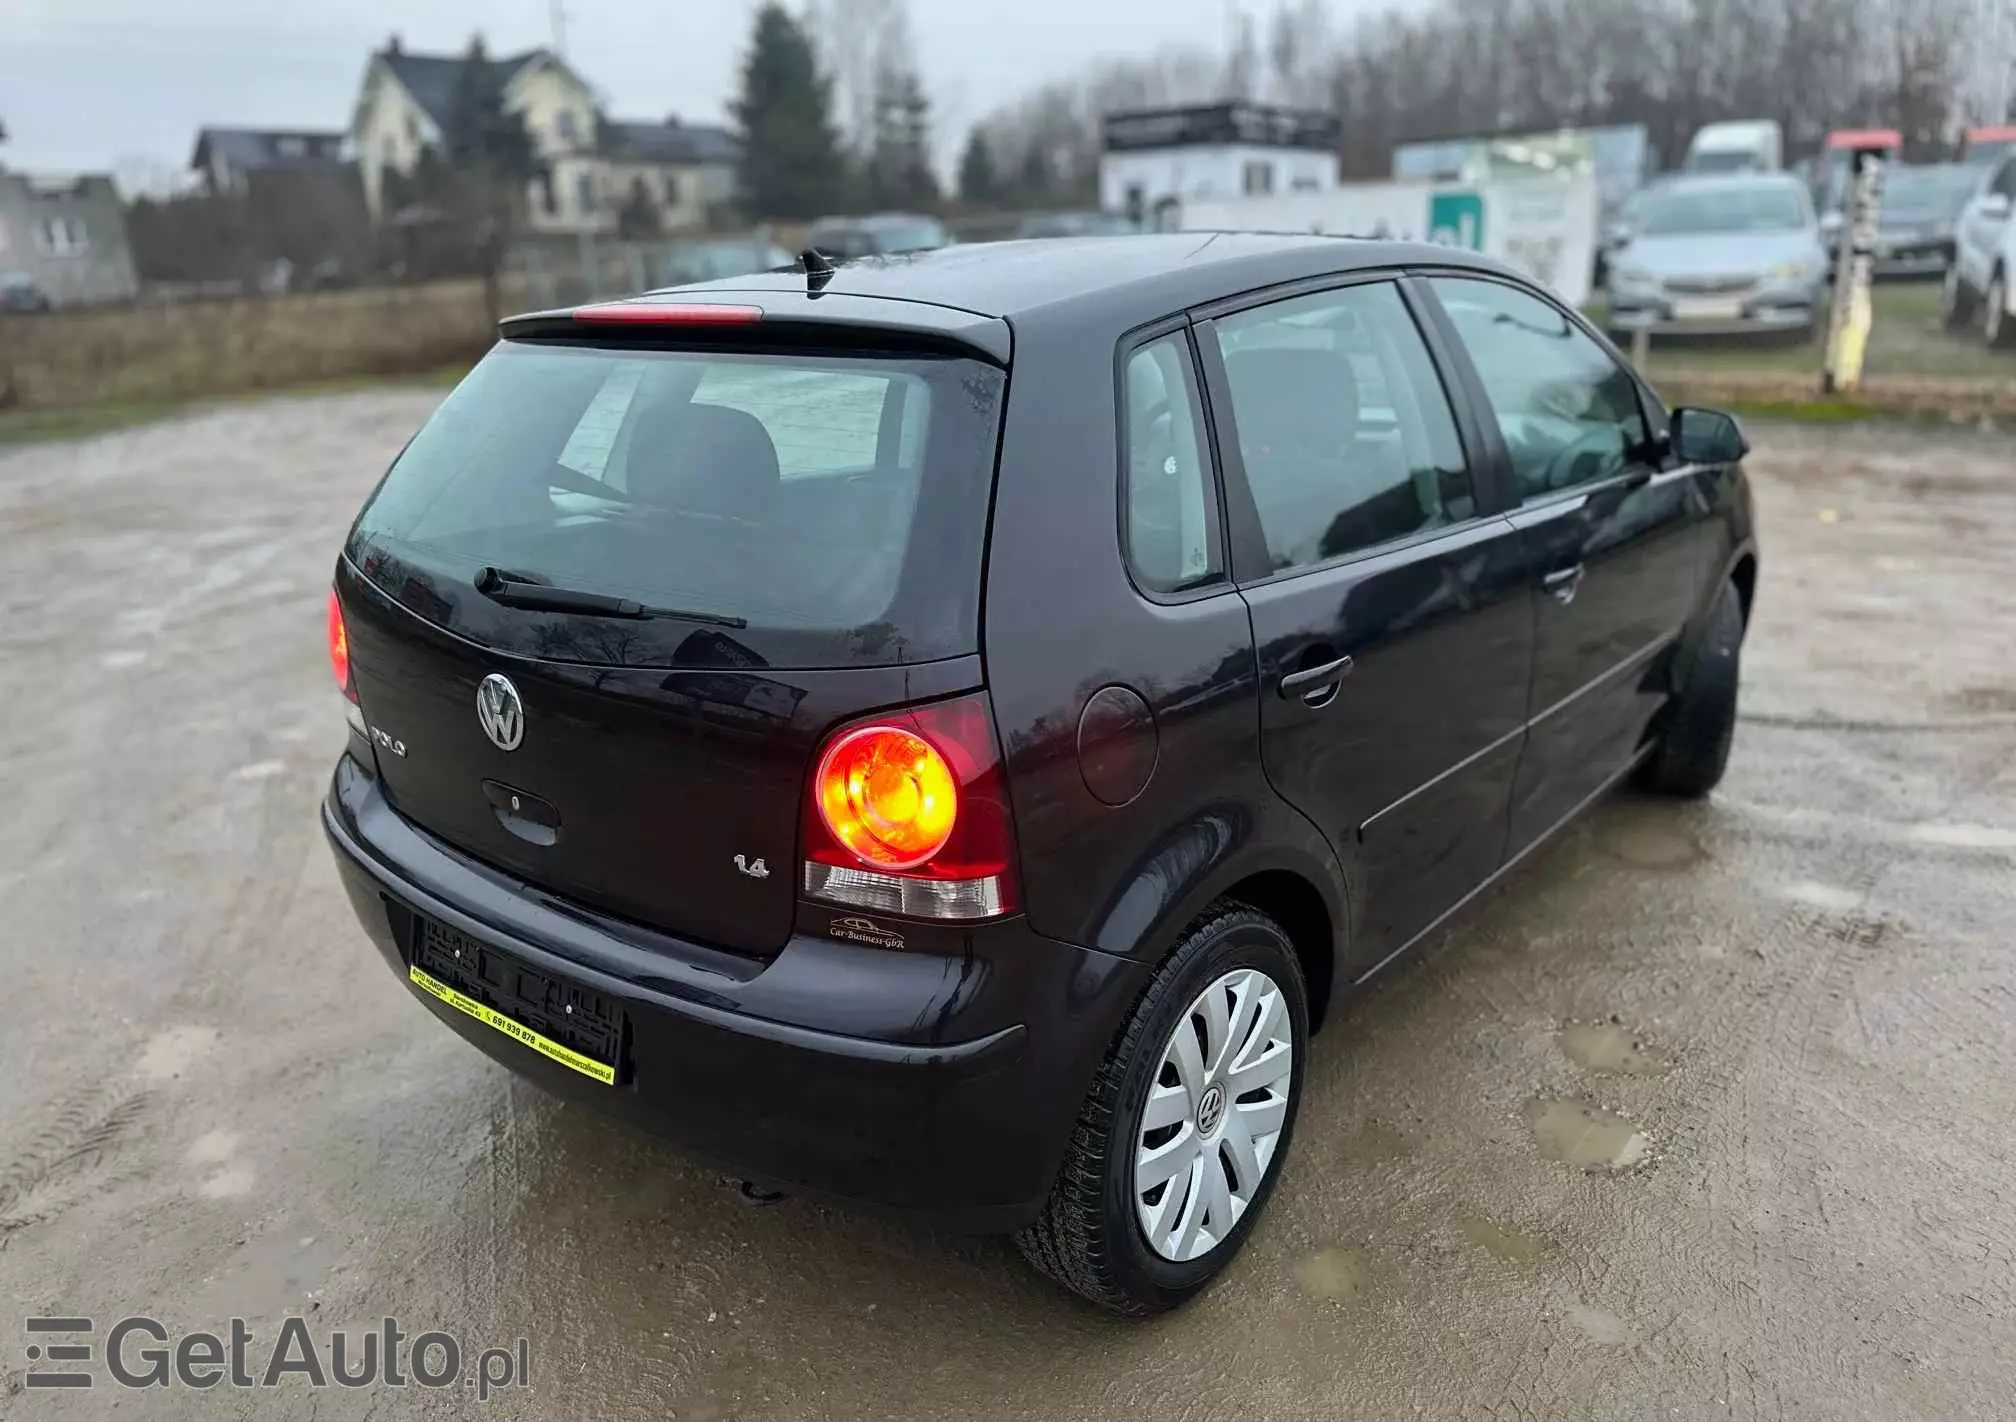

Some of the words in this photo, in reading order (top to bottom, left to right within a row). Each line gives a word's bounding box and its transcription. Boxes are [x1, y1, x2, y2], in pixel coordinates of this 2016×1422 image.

[492, 1015, 506, 1029] 691
[506, 1022, 521, 1036] 939
[521, 1031, 536, 1045] 878
